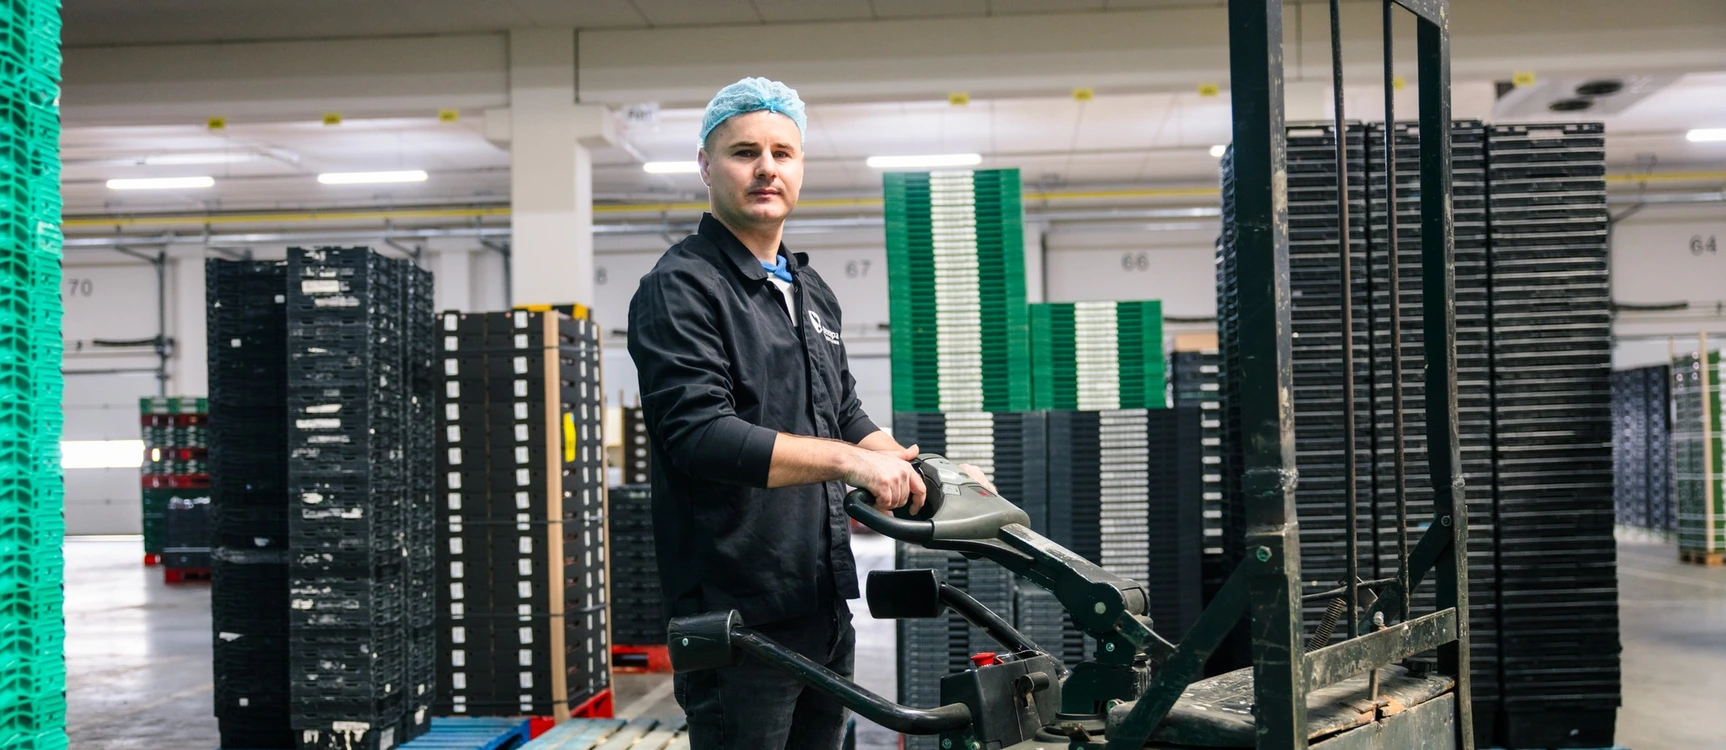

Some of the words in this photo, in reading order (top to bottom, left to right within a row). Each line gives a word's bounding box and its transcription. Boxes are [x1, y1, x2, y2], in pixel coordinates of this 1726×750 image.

[1690, 233, 1717, 256] 64
[845, 260, 871, 278] 67
[1121, 252, 1149, 272] 66
[68, 278, 93, 297] 70
